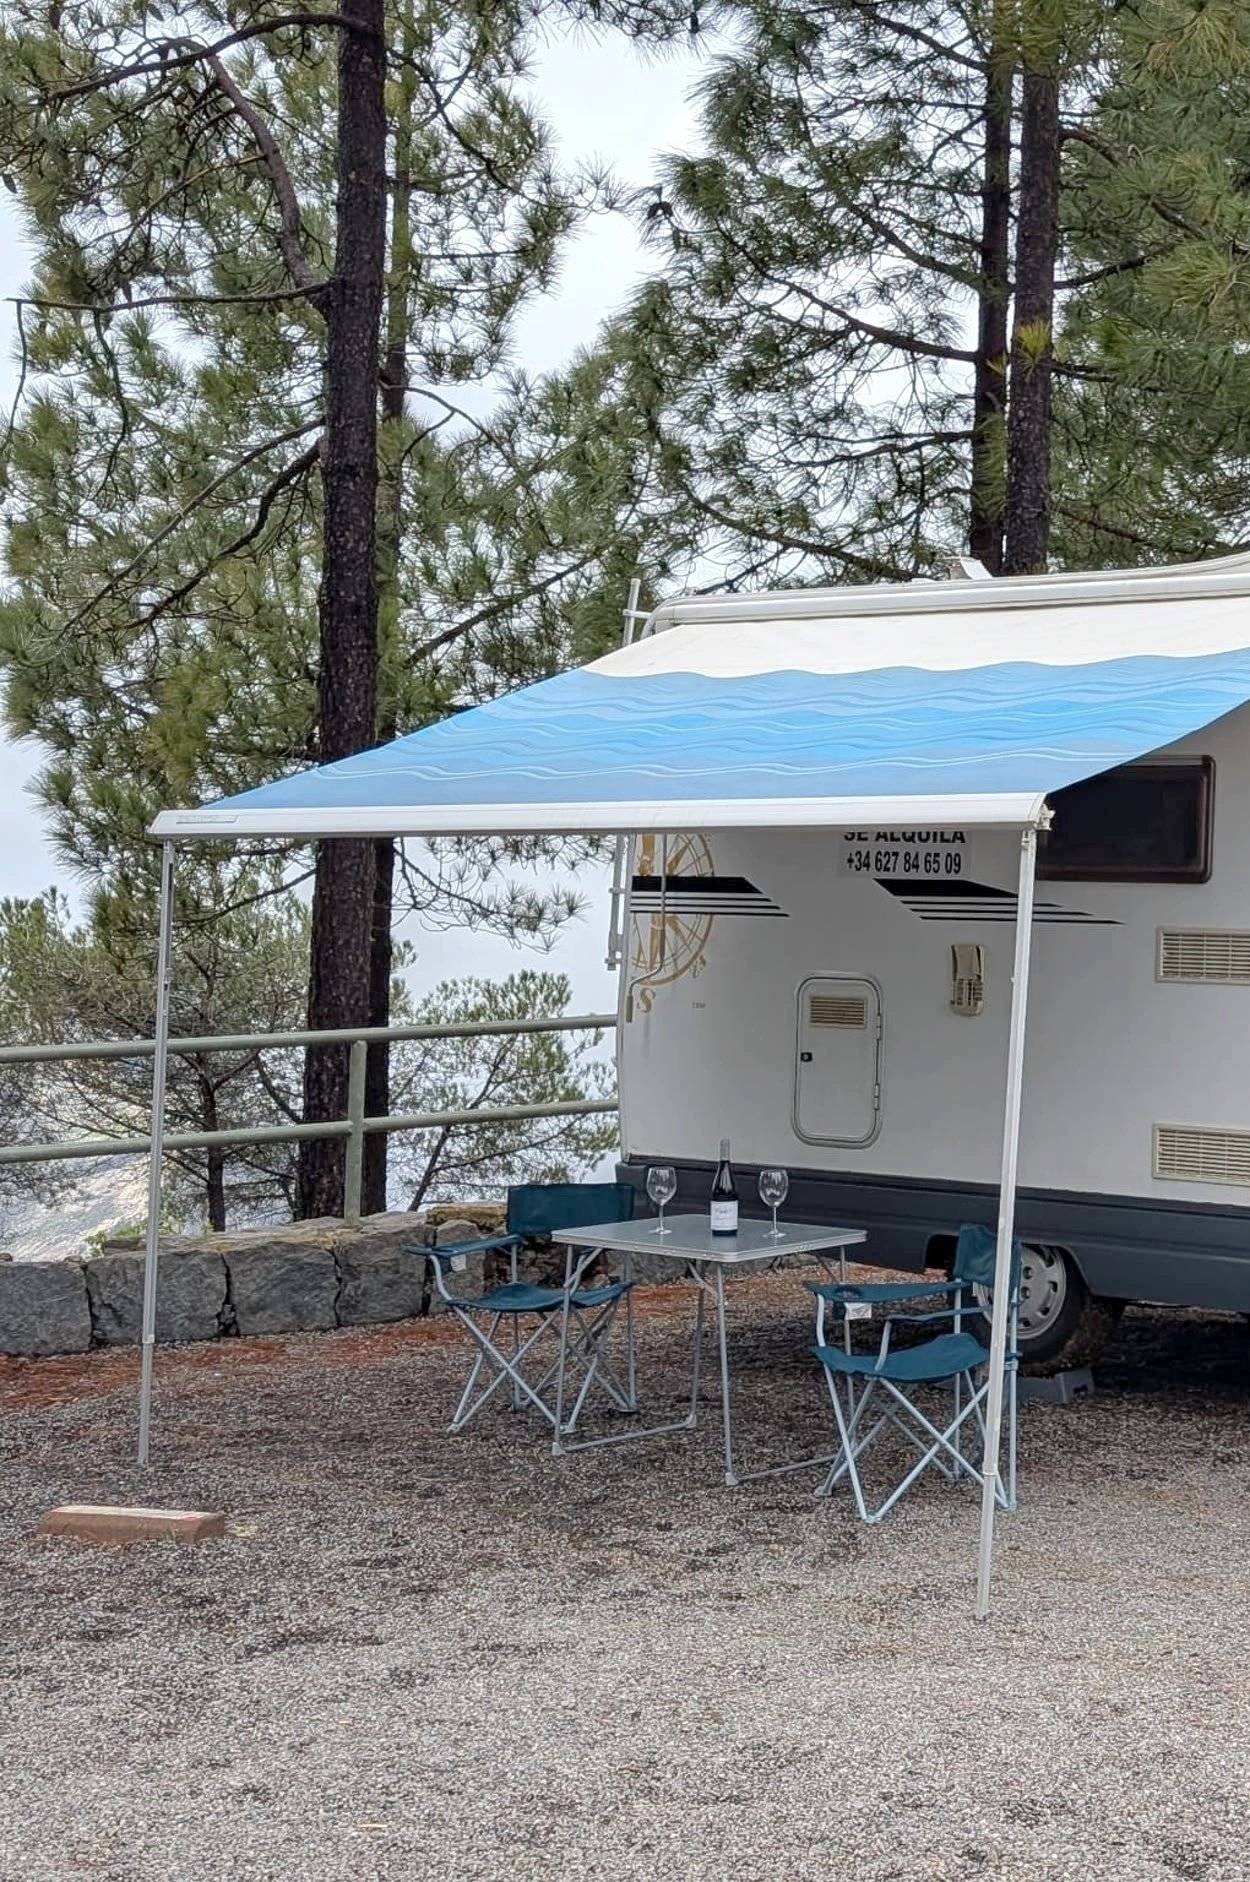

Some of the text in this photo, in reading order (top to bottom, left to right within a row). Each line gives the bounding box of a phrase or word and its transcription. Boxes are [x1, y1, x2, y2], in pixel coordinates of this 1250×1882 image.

[876, 831, 966, 843] ALQUILA
[847, 850, 962, 874] +34 627 84 65 09
